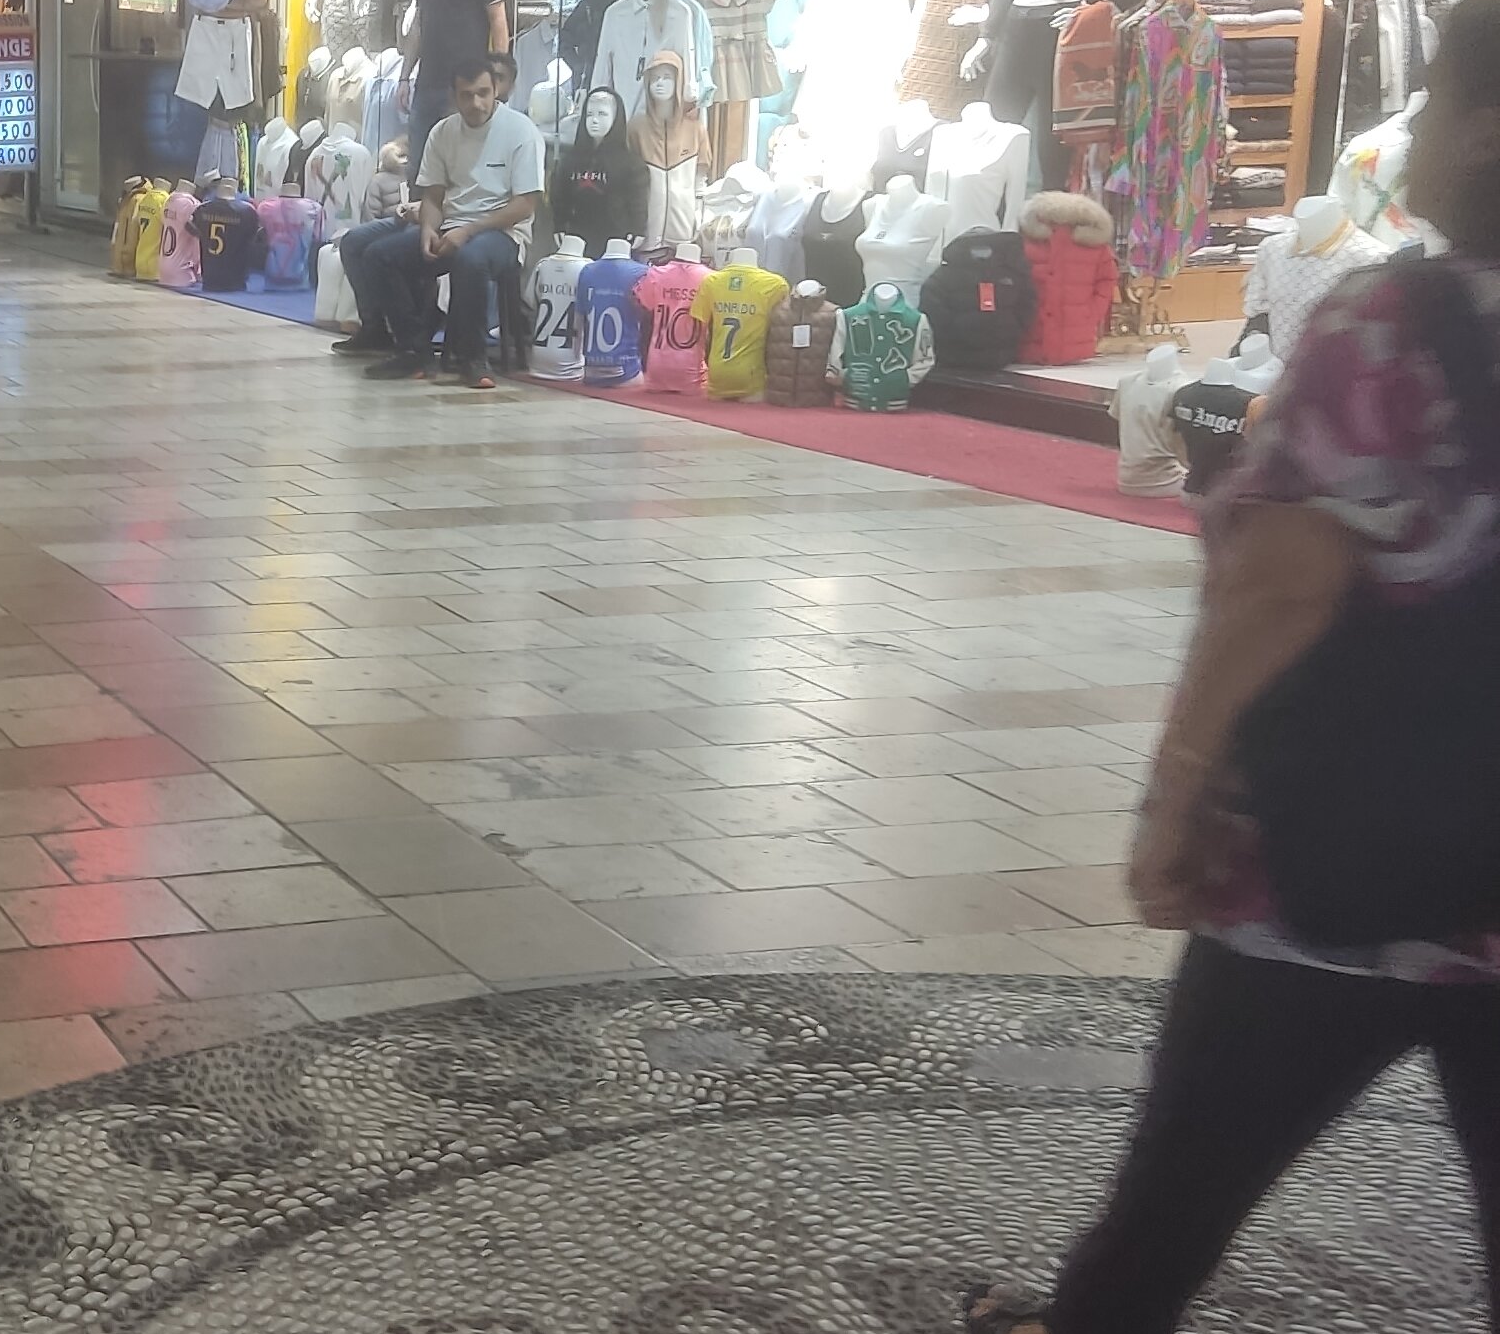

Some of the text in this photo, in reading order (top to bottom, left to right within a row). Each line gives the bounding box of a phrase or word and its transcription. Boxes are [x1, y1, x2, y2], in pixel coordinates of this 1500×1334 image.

[208, 223, 226, 255] 5
[663, 286, 697, 301] MESS
[533, 298, 577, 349] 24
[586, 305, 623, 354] 10
[654, 303, 699, 350] 10
[722, 317, 741, 360] 7
